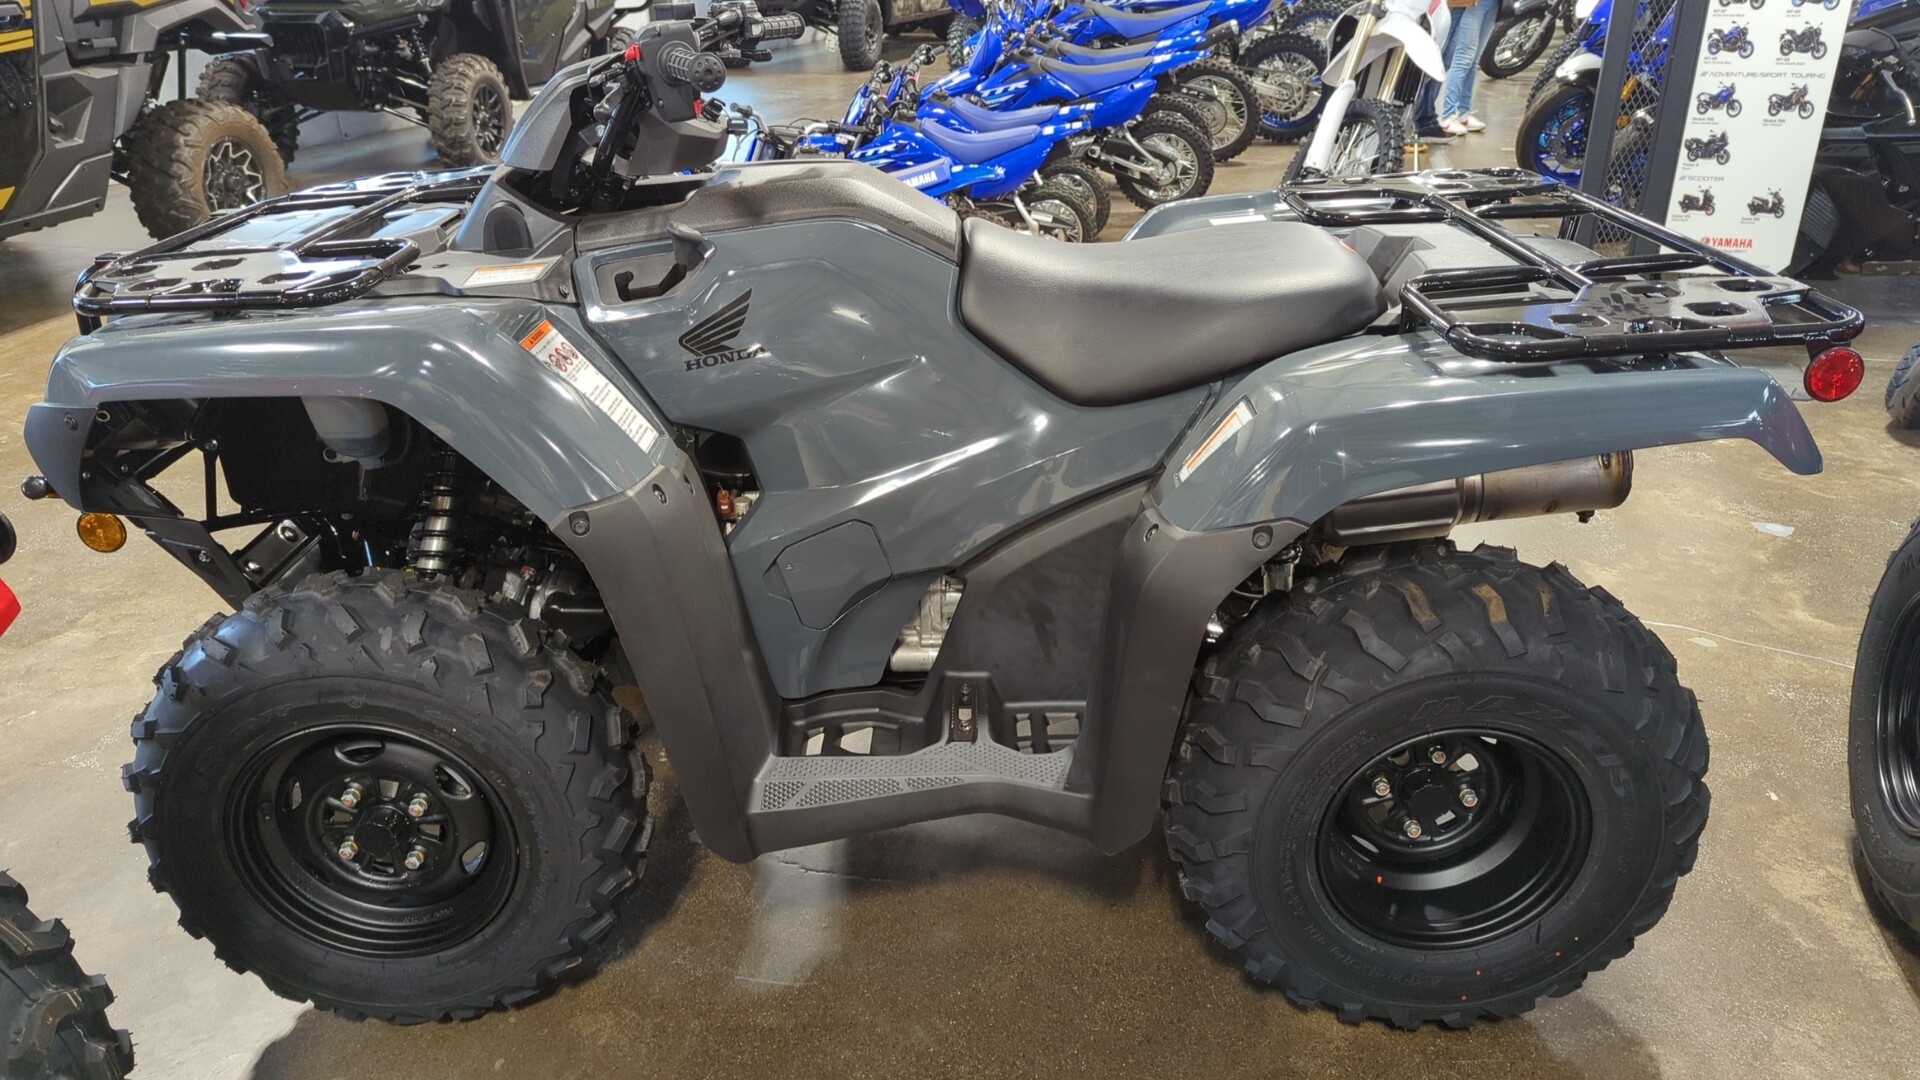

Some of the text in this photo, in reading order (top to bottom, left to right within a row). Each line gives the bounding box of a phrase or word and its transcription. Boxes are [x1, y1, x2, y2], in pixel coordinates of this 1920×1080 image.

[903, 170, 938, 188] AMAHA
[1711, 237, 1753, 248] YAMAHA
[684, 346, 771, 372] HONDA
